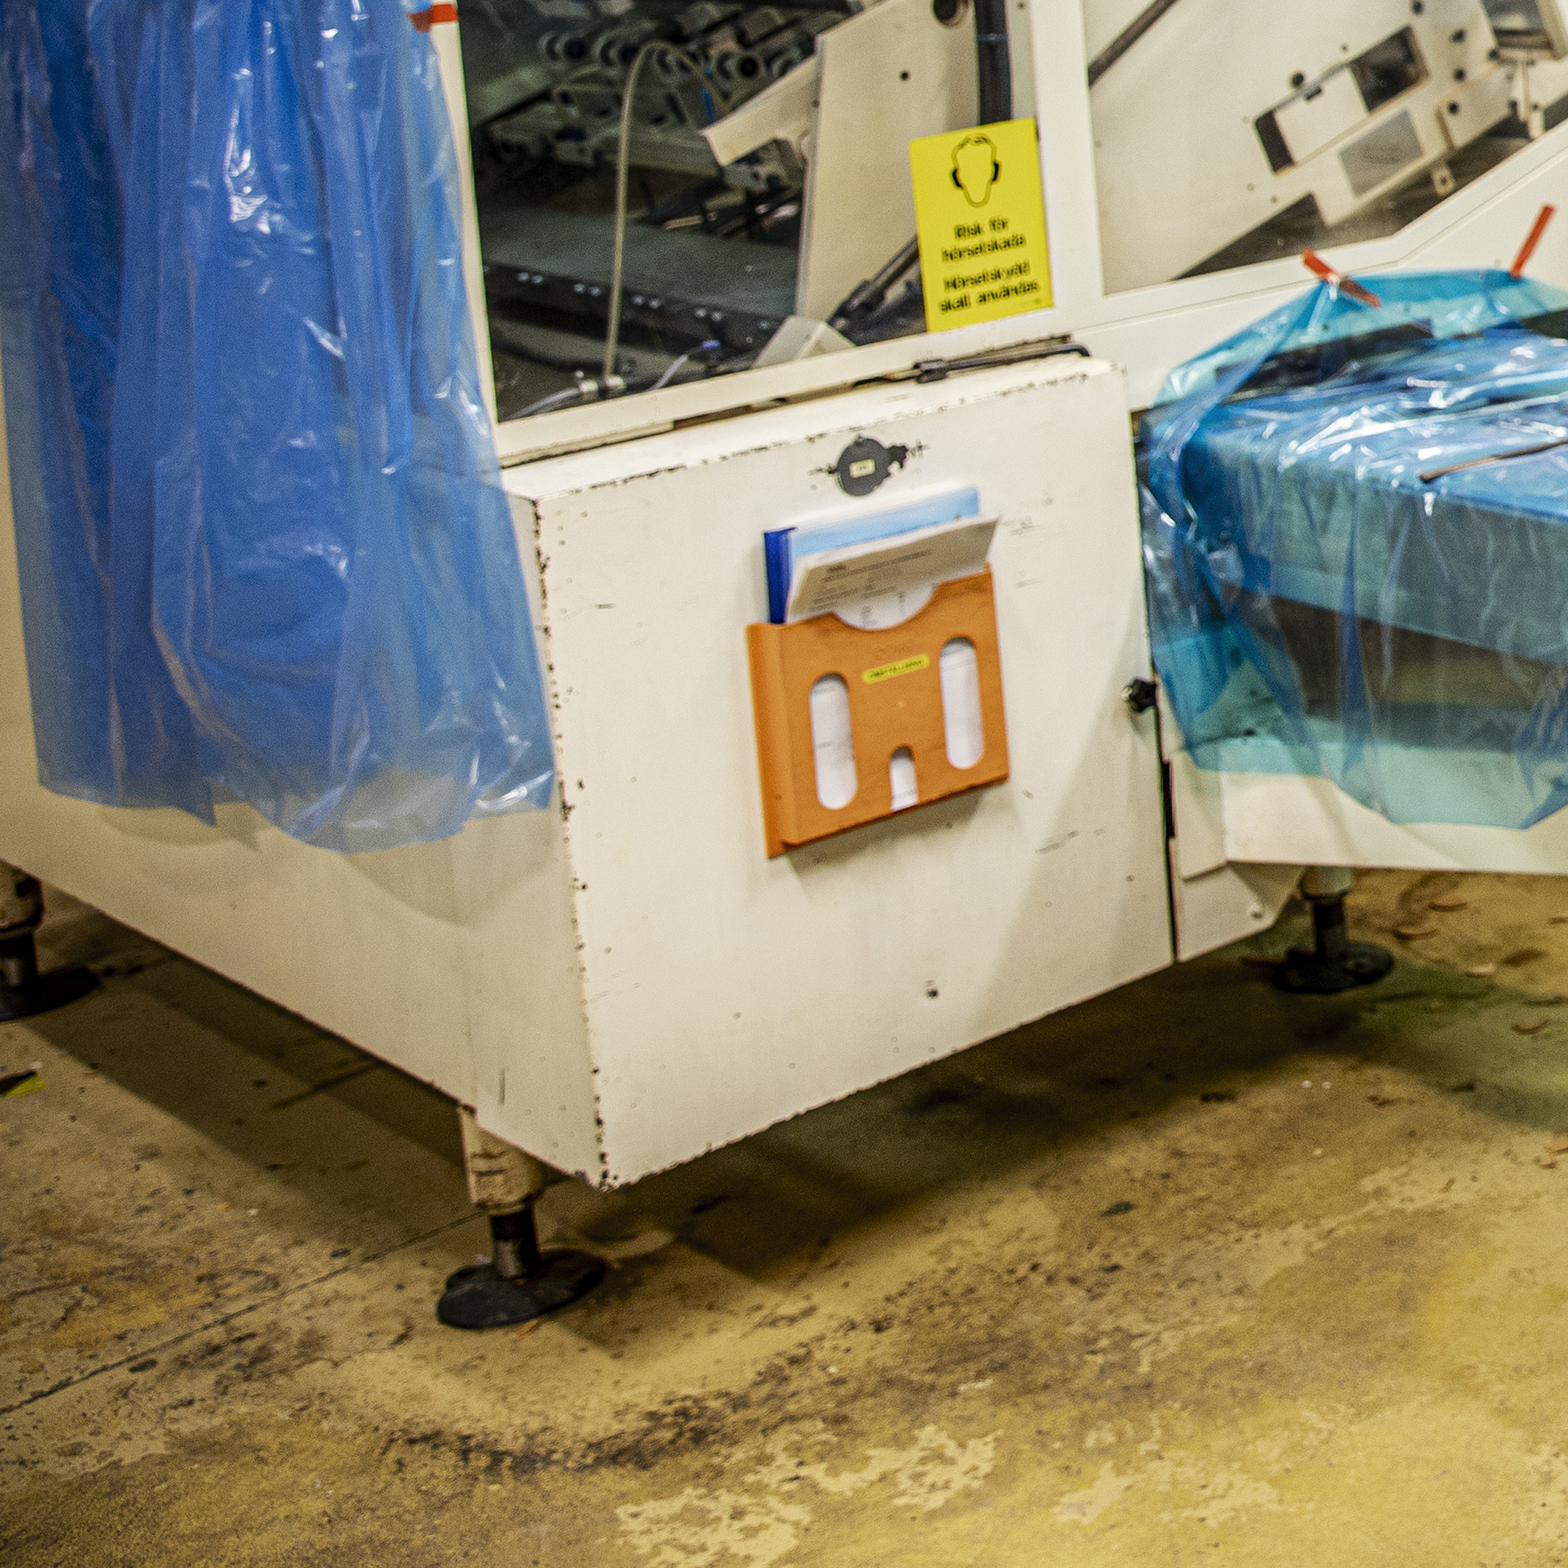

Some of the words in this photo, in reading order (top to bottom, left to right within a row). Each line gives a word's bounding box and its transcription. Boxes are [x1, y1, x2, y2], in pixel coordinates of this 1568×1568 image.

[954, 221, 984, 239] Risk
[989, 216, 1009, 232] för
[941, 234, 1026, 263] hörselskada
[943, 260, 1030, 292] Hörselskydd
[939, 295, 971, 314] skall
[976, 280, 1039, 305] användas
